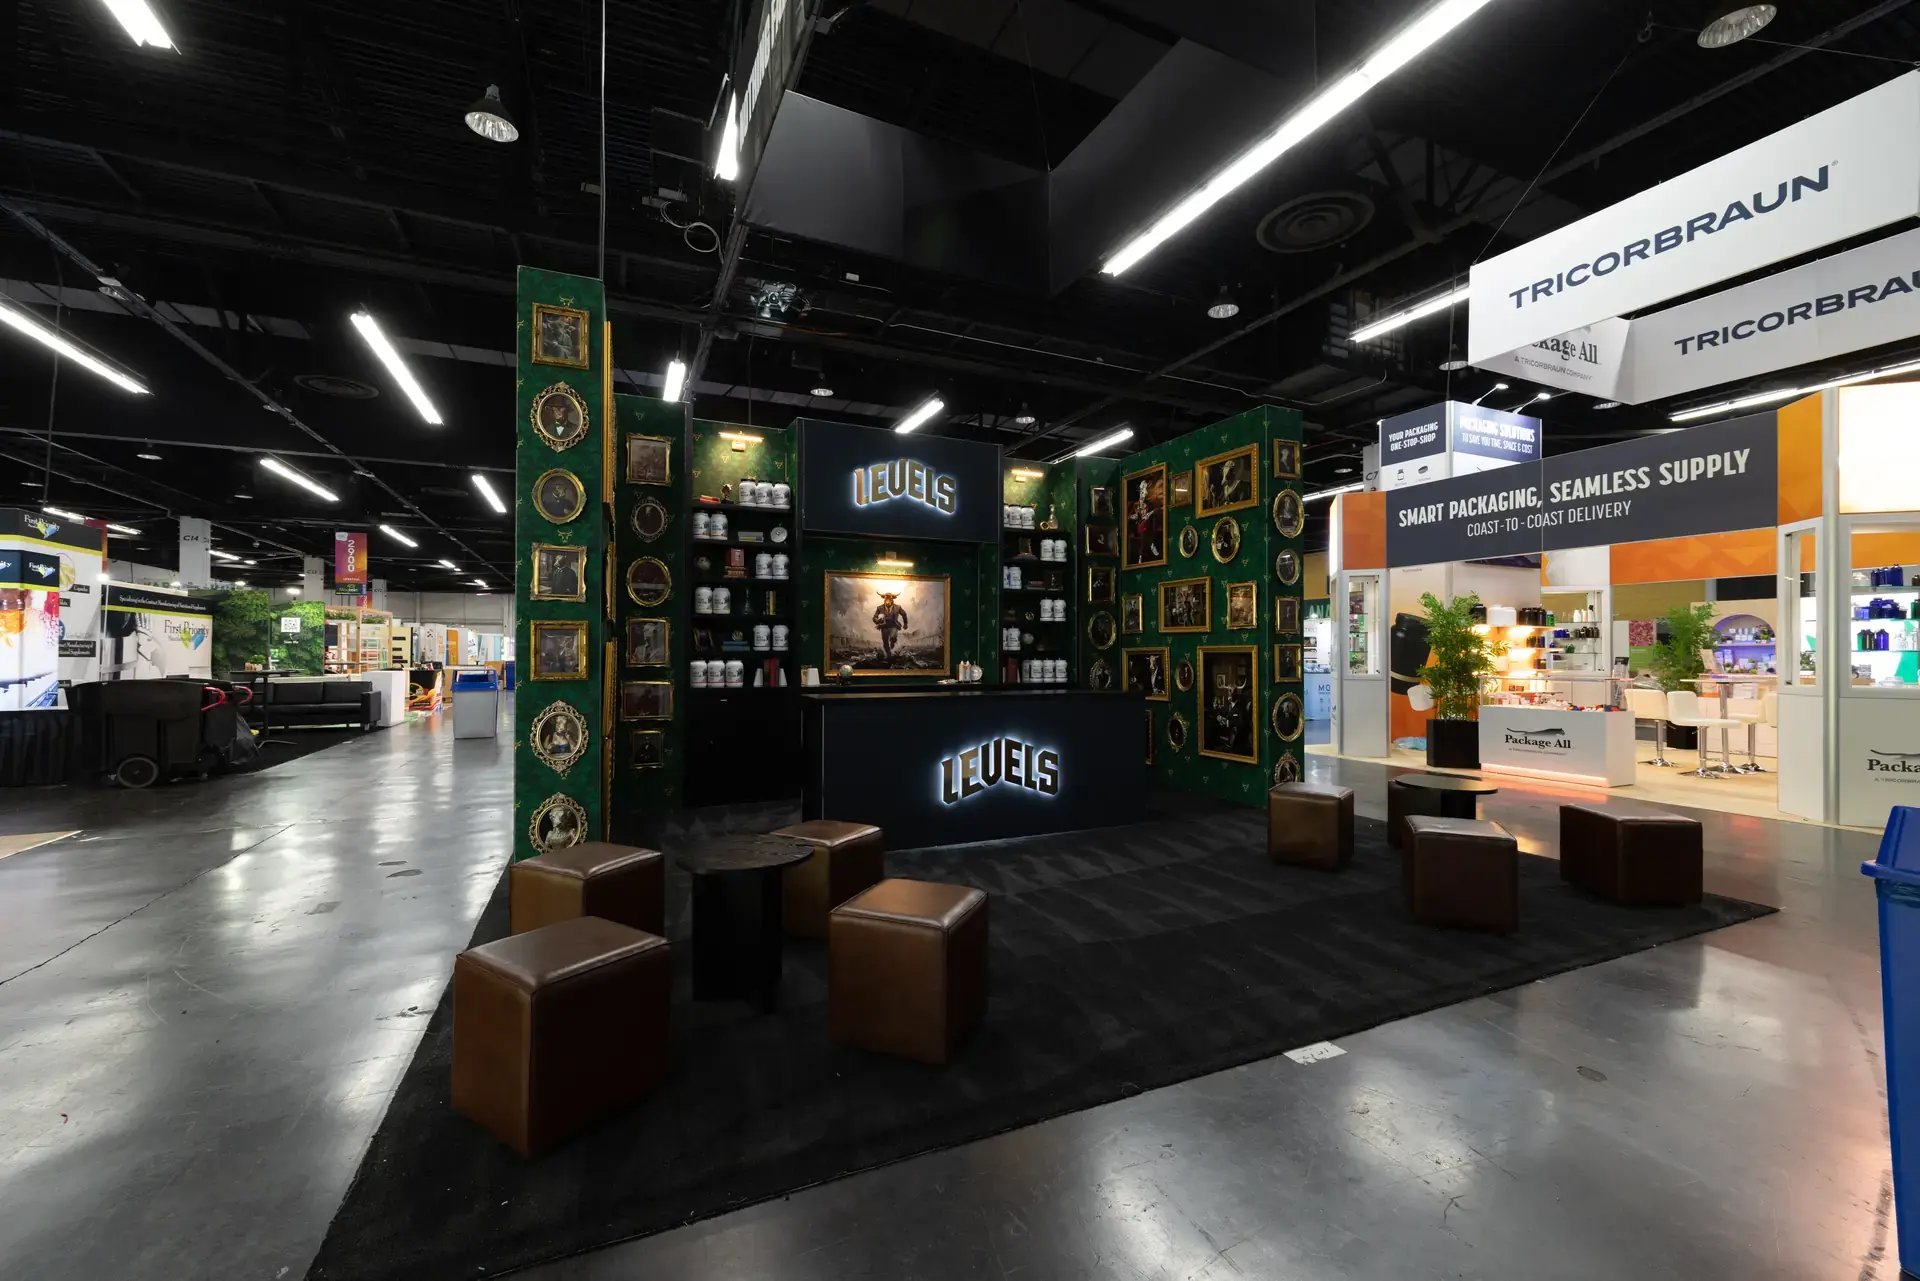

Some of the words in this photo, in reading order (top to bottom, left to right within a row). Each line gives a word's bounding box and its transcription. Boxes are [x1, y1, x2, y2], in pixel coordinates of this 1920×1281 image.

[1509, 165, 1828, 309] TRICORBRAUN
[1579, 341, 1599, 364] All
[1521, 357, 1566, 373] TRICORBRAUN
[1389, 430, 1404, 442] YOUR
[1405, 421, 1438, 437] PACKAGING
[1390, 433, 1436, 451] ONE-STOP-SHOP
[1462, 432, 1468, 442] TO
[1469, 434, 1480, 444] SAVE
[1481, 436, 1490, 447] YOU
[1503, 440, 1517, 451] SPACE
[1522, 444, 1533, 453] COST
[1365, 470, 1379, 481] C7
[854, 459, 957, 515] LEVELS
[1399, 502, 1444, 528] SMART
[1449, 486, 1542, 520] PACKAGING,
[1549, 466, 1651, 504] SEAMLESS
[1658, 448, 1750, 486] SUPPLY
[1568, 500, 1632, 524] DELIVERY
[347, 539, 355, 572] 2900
[164, 620, 181, 633] First
[1505, 734, 1552, 749] Package
[1554, 738, 1571, 749] All
[940, 737, 1059, 805] LEVELS
